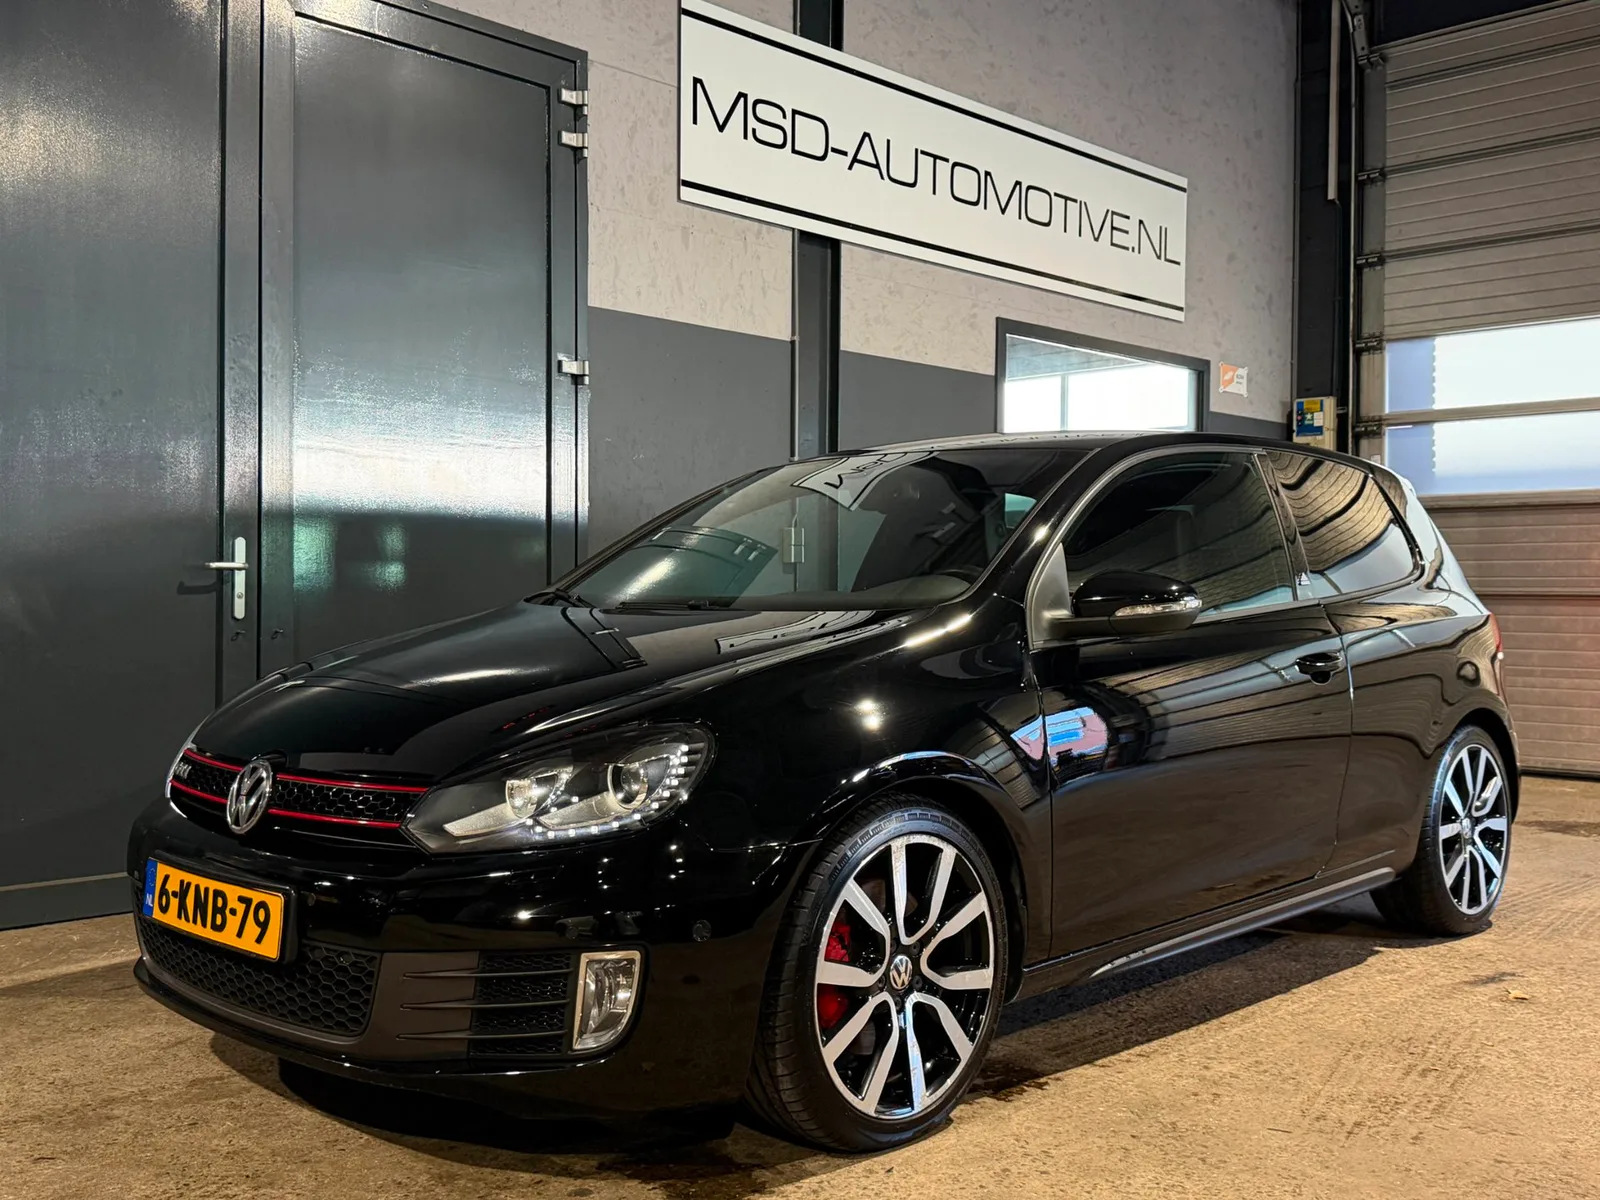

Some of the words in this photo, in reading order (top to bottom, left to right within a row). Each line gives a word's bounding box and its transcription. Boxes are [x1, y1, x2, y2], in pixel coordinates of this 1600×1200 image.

[692, 76, 1181, 266] MSD-AUTOMOTIVE.NL
[145, 893, 153, 907] NL
[158, 873, 270, 944] 6-KNB-79
